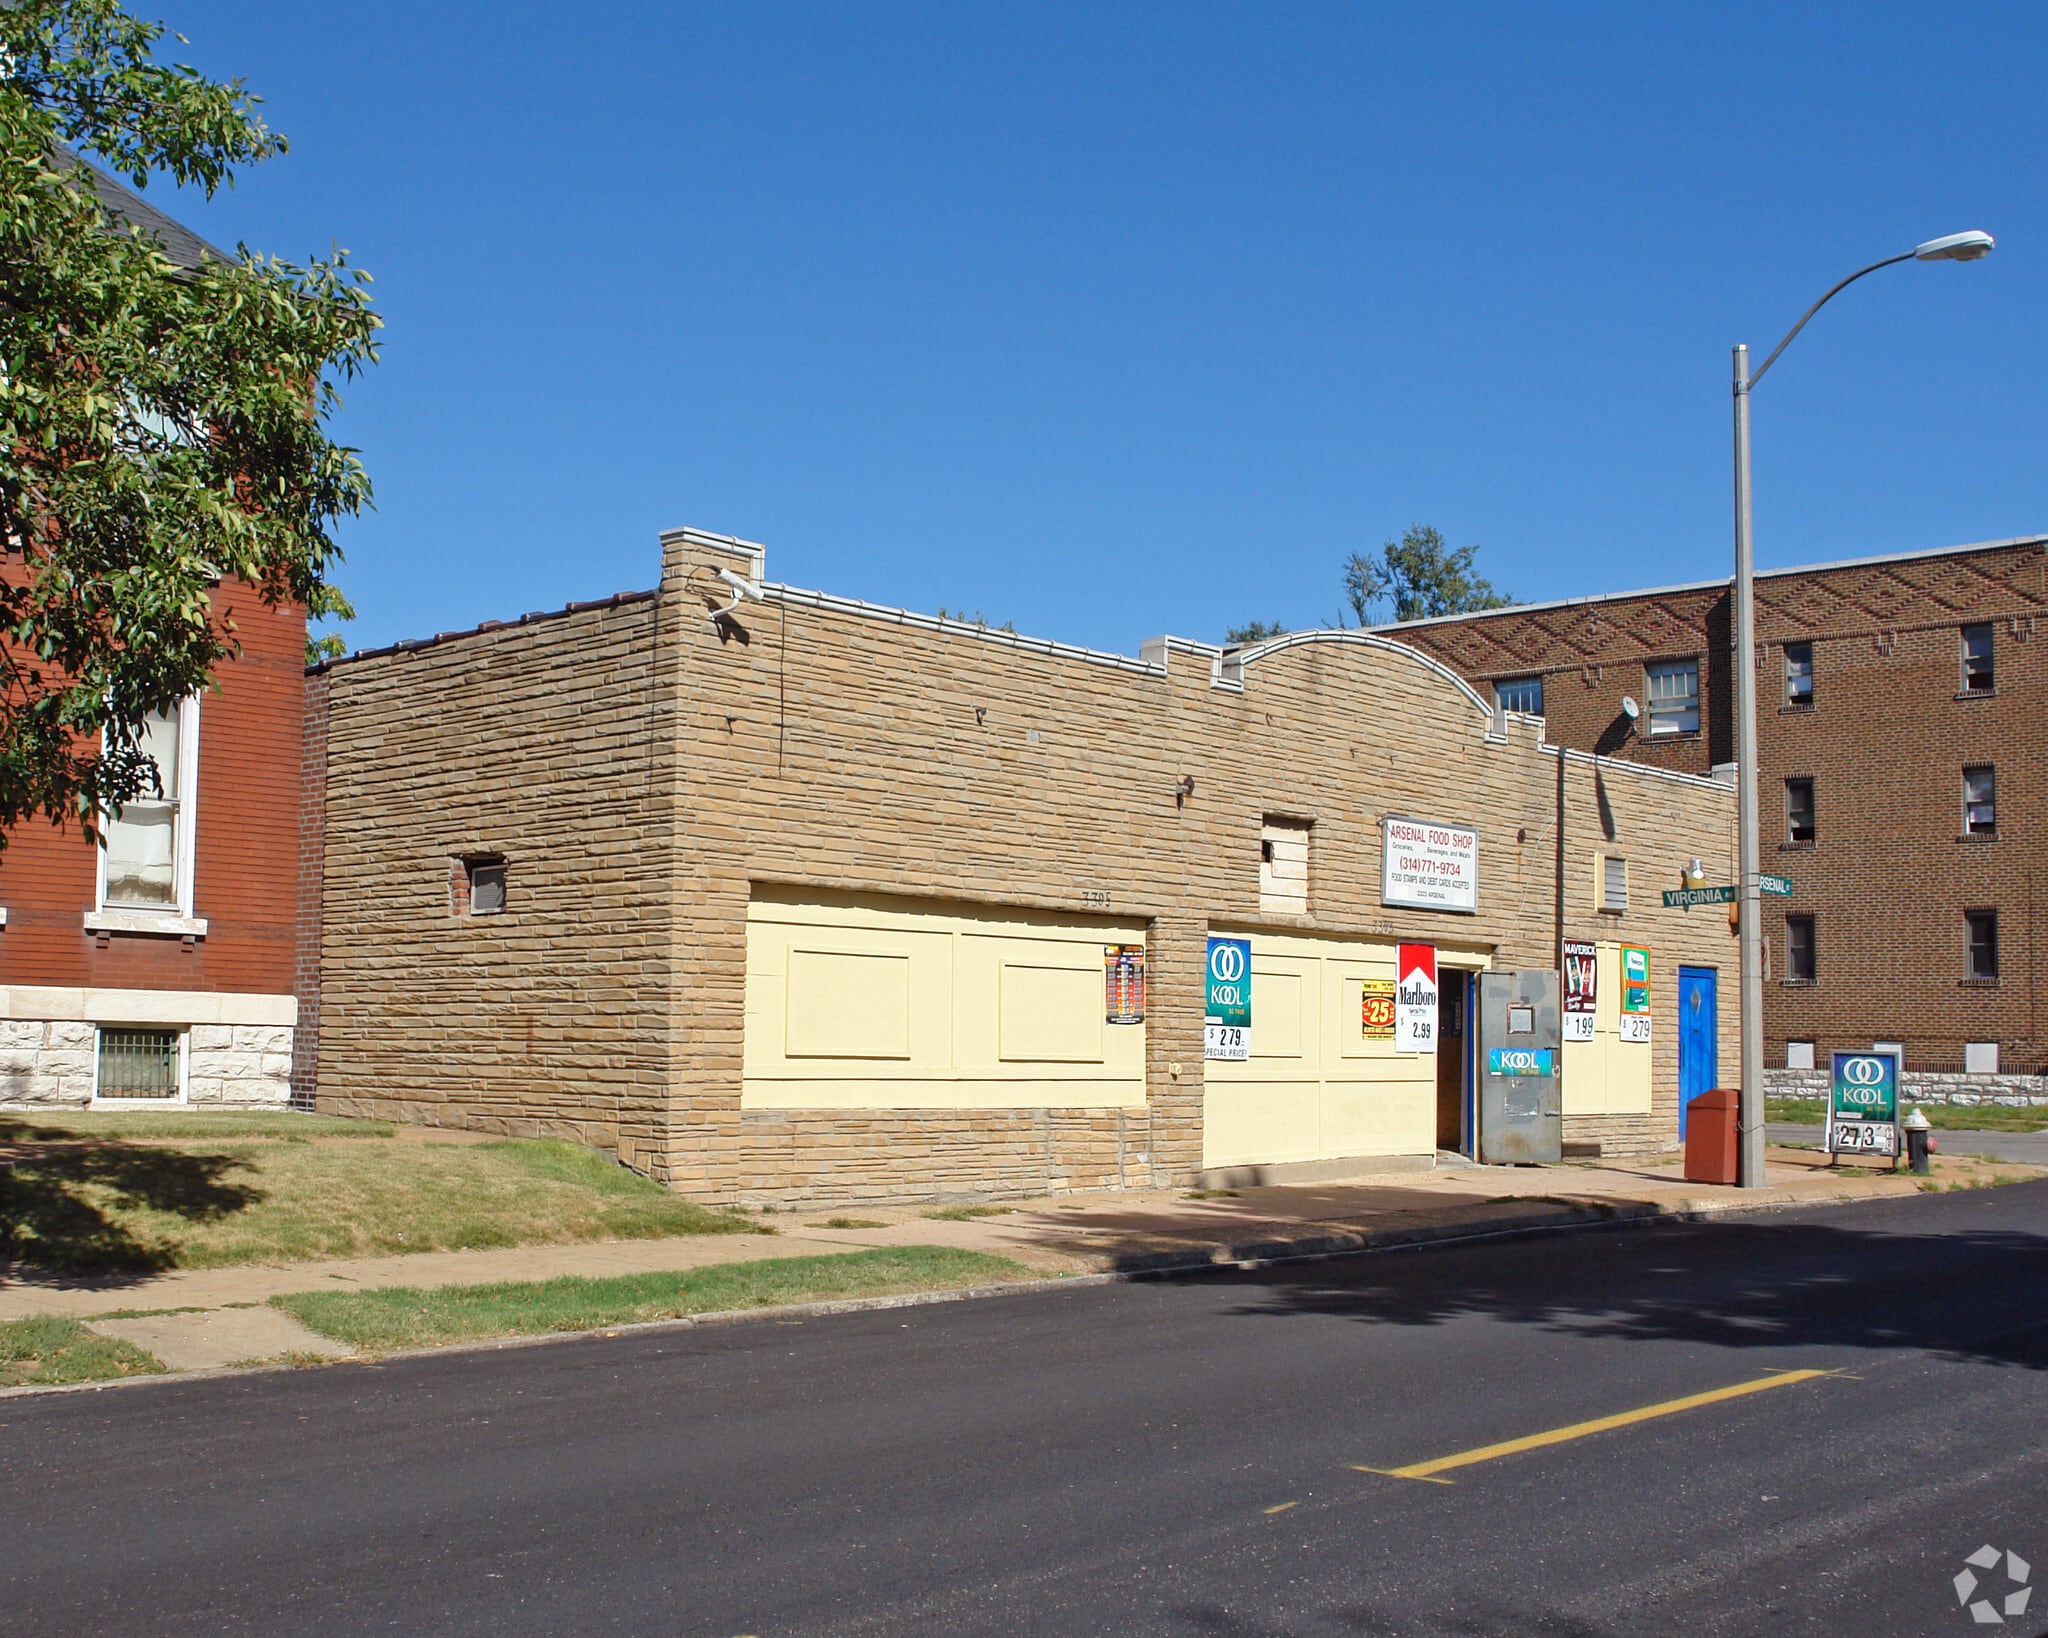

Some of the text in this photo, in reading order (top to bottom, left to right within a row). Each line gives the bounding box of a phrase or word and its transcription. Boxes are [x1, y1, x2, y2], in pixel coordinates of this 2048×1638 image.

[1391, 825, 1473, 849] ARSENAL FOOD SHOP
[1391, 873, 1402, 882] FOOD
[1403, 874, 1418, 884] STAMPS
[1760, 876, 1786, 893] RSENAL
[1667, 889, 1723, 905] VIRGINIA
[1565, 944, 1595, 956] MAVERICK
[1211, 985, 1244, 1006] KOOL
[1399, 982, 1436, 1005] Marlboro
[1413, 1022, 1431, 1039] 2.99
[1501, 1051, 1539, 1069] KOOL
[1843, 1088, 1887, 1105] KOOL
